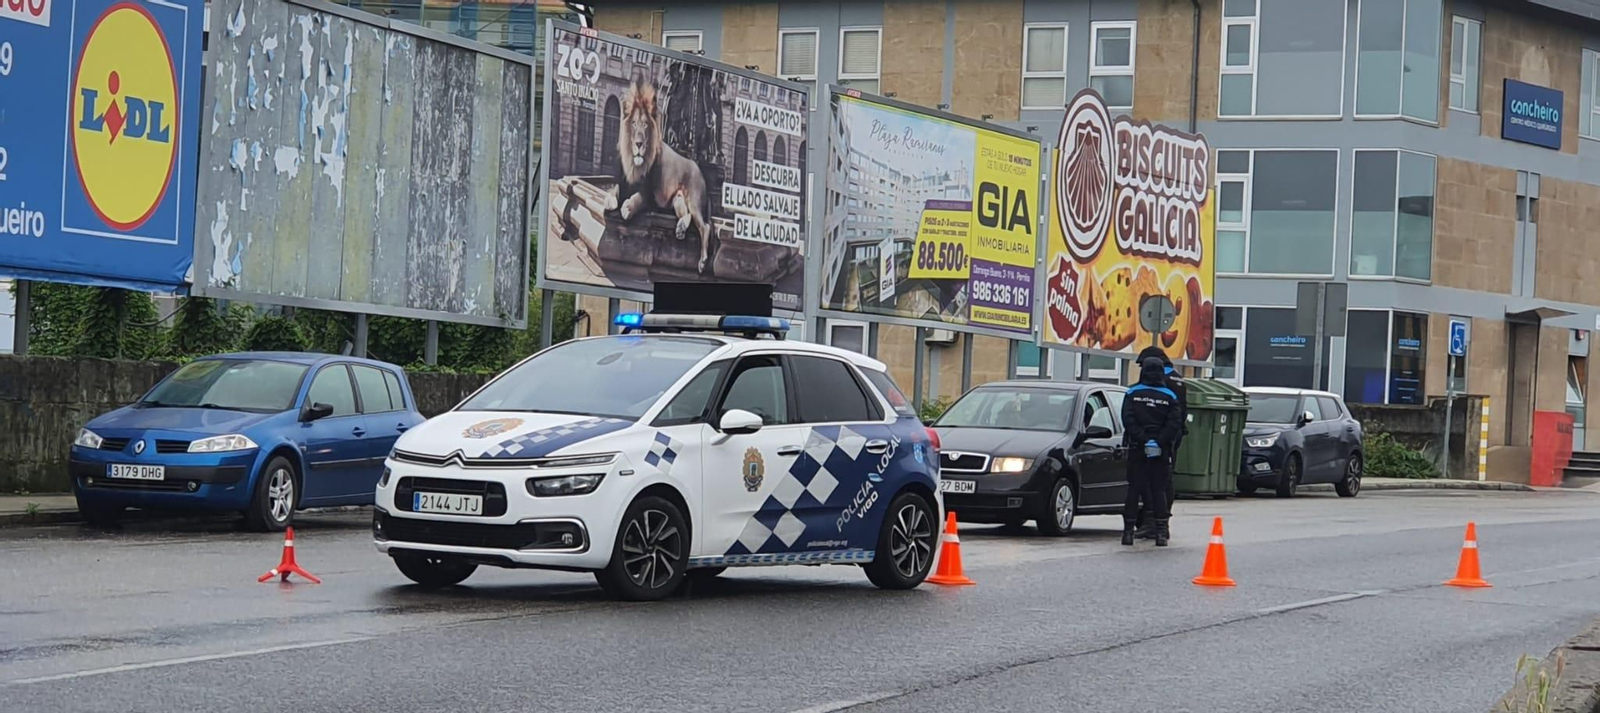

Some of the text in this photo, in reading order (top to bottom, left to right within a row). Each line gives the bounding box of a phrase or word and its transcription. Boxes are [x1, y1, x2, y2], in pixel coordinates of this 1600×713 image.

[557, 80, 578, 96] SANTO
[737, 100, 800, 132] ¿VA A OPORTO?
[1511, 99, 1559, 123] concheiro
[755, 163, 799, 188] DESCUBRA
[1117, 129, 1206, 195] BISCUITS
[725, 187, 798, 216] EL LADO SALVAJE
[978, 181, 1032, 235] GIA
[737, 218, 798, 244] DE LA CIUDAD
[1118, 195, 1197, 251] GALICIA
[977, 236, 1030, 254] INMOBILIARIA
[973, 280, 1029, 307] 986 336 161
[1060, 269, 1075, 297] sin
[1048, 287, 1079, 328] palma
[113, 465, 162, 478] 3179 DHG
[836, 434, 901, 532] POLICÍA LOCAL
[421, 495, 479, 511] 2144 JTJ
[857, 491, 878, 518] VIGO
